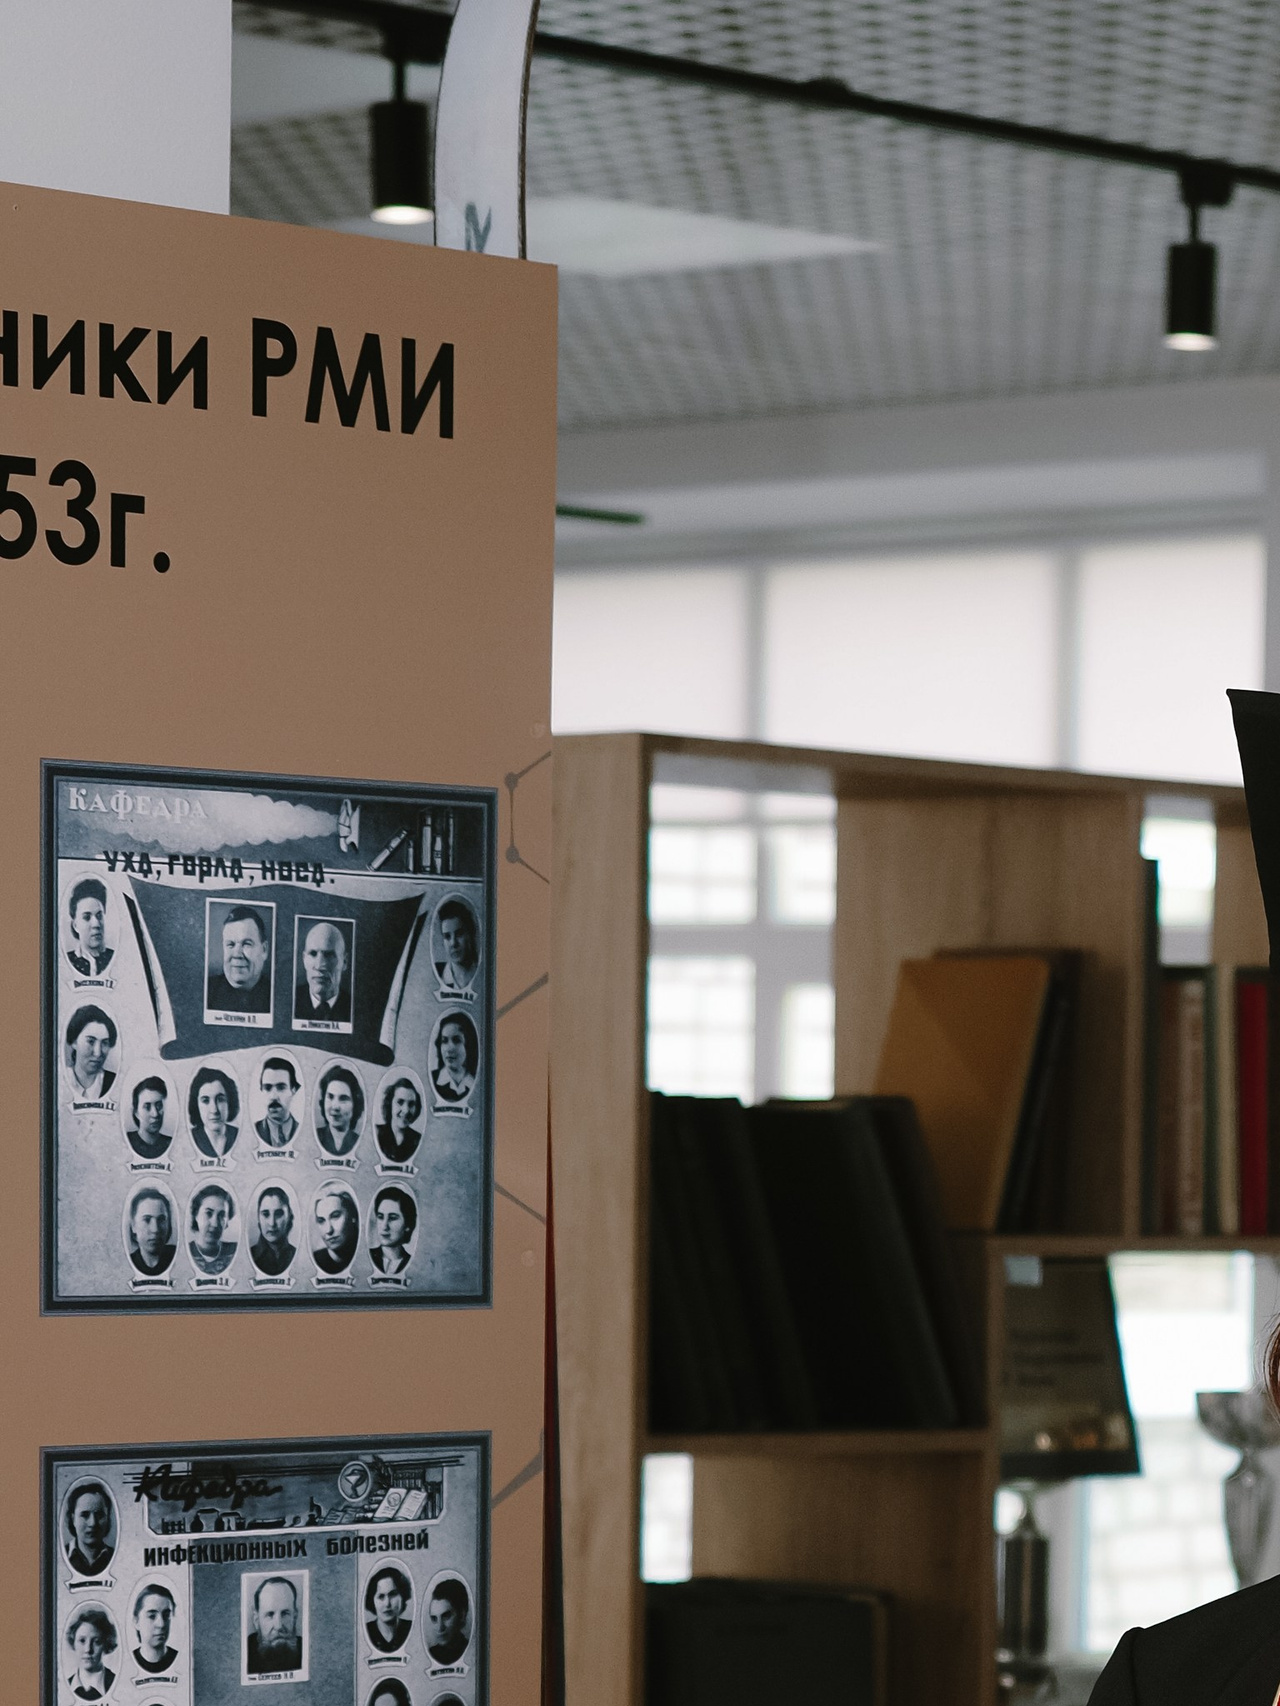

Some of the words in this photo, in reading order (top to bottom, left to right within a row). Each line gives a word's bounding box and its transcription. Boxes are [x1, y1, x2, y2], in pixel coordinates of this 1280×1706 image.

[251, 317, 455, 439] РМИ
[68, 787, 208, 824] КАФЕДРА
[143, 1538, 308, 1567] ИНФЕКЦИОННЫХ
